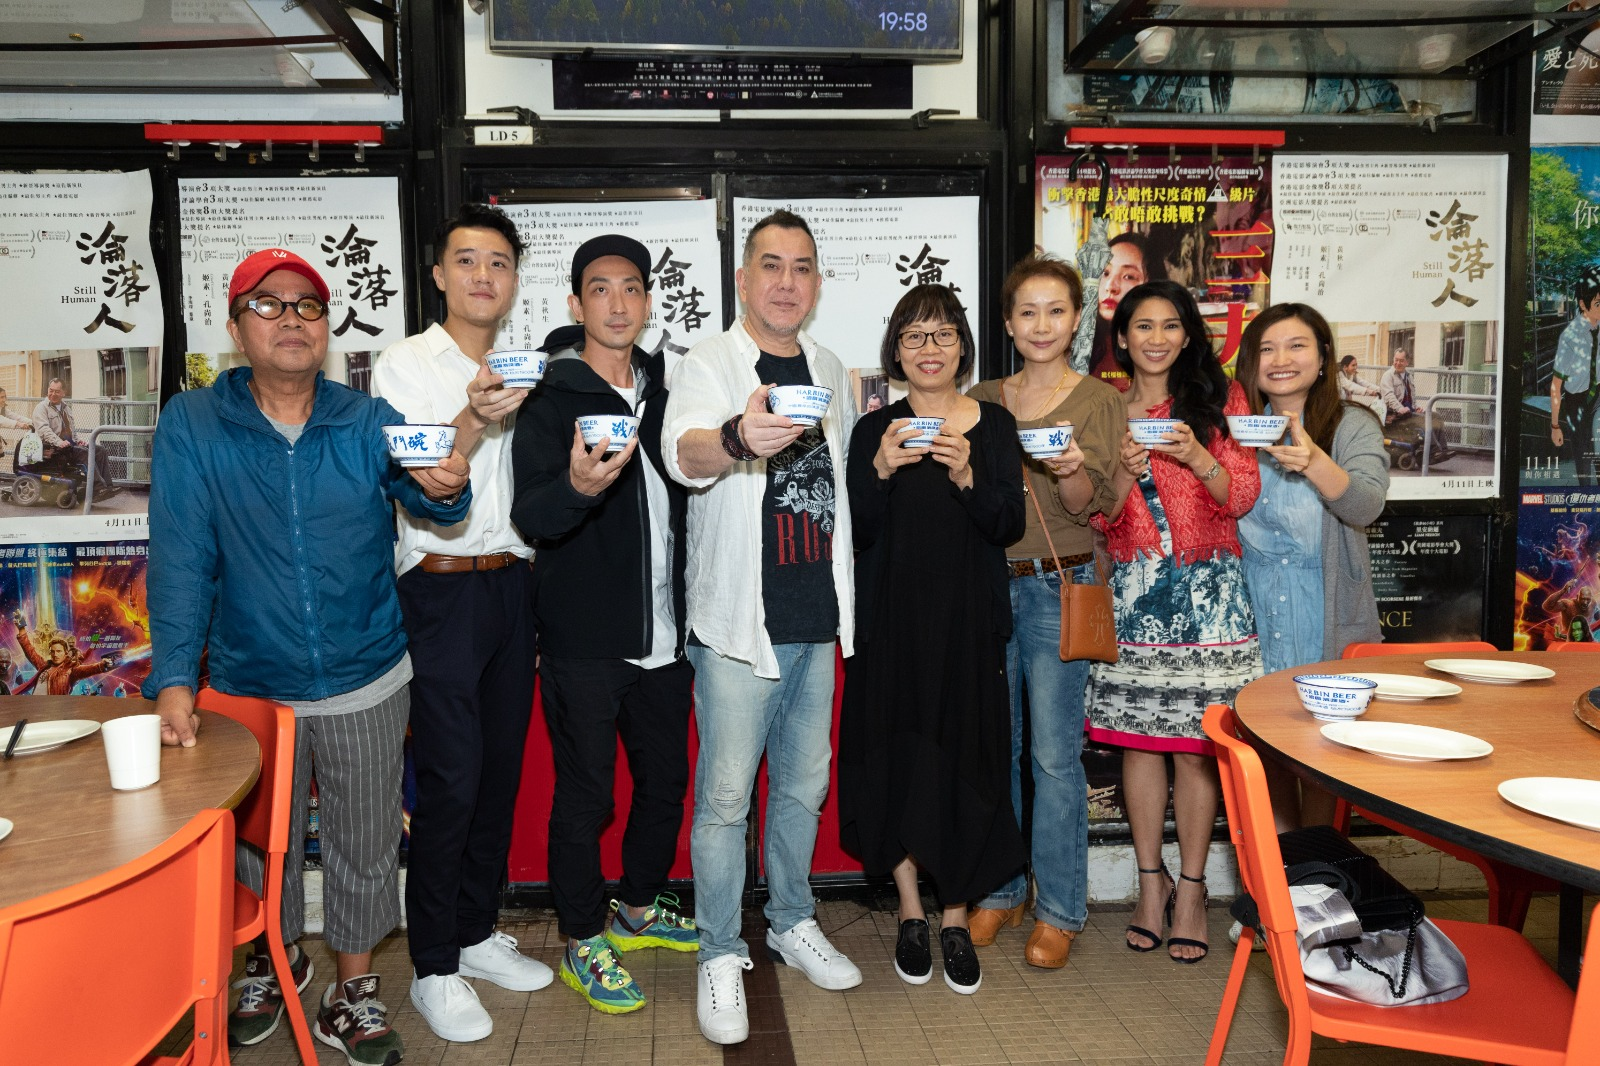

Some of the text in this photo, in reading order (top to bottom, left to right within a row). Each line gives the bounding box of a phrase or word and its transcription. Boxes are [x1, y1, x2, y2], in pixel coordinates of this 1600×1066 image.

[879, 12, 928, 32] 19:58
[490, 131, 518, 142] LD 5
[1103, 205, 1205, 223] 敢唔敢挑戰？
[1573, 200, 1598, 230] 你
[1425, 199, 1494, 307] 淪落人
[1424, 262, 1443, 270] Still
[75, 220, 151, 335] 淪落人
[320, 223, 399, 337] 淪落人
[1412, 271, 1443, 279] Human
[74, 286, 97, 295] Still
[61, 295, 97, 303] Human
[797, 389, 824, 398] HARBIN
[1525, 456, 1560, 470] 11.11
[1442, 480, 1494, 488] 4月11日上映
[1522, 494, 1544, 504] MARVEL
[1544, 494, 1566, 504] STUDIOS
[1300, 687, 1330, 698] HARBIN
